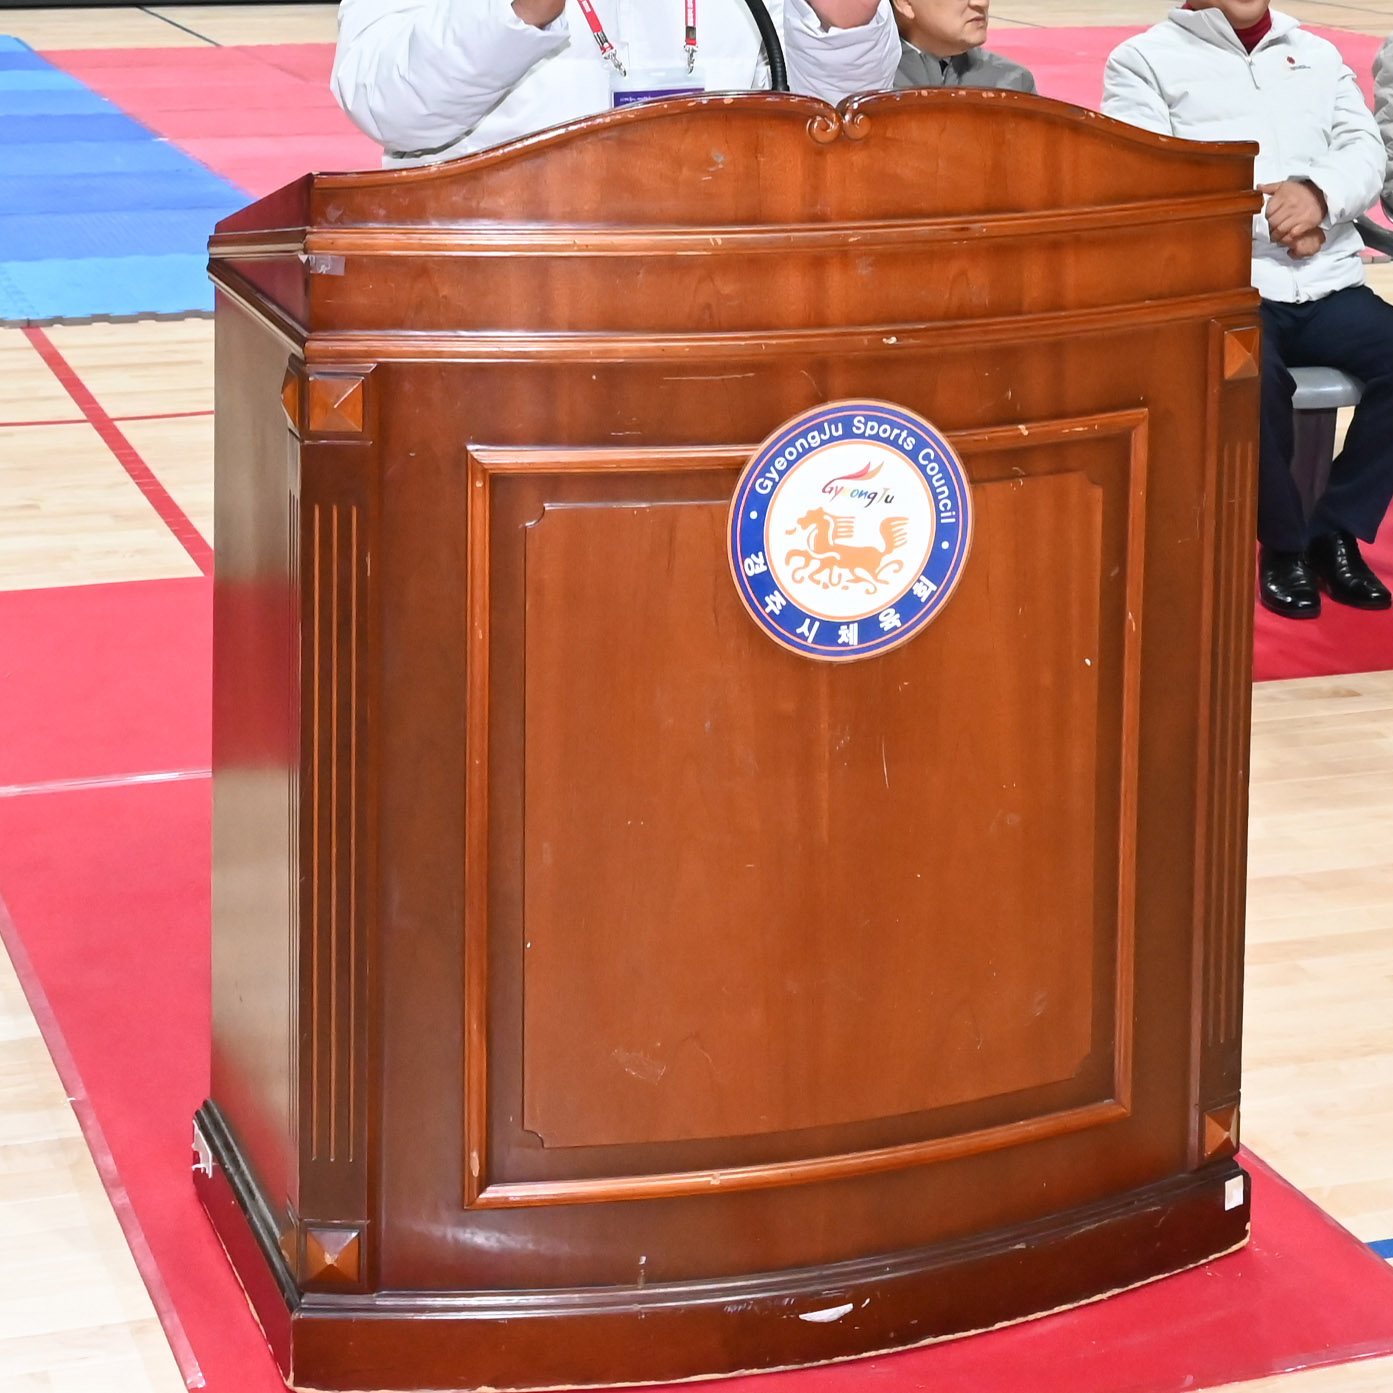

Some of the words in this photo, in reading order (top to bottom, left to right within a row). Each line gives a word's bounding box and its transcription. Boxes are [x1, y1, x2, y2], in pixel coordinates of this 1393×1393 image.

[755, 421, 844, 495] GyeongJu
[852, 415, 916, 451] Sports
[918, 447, 956, 525] Council
